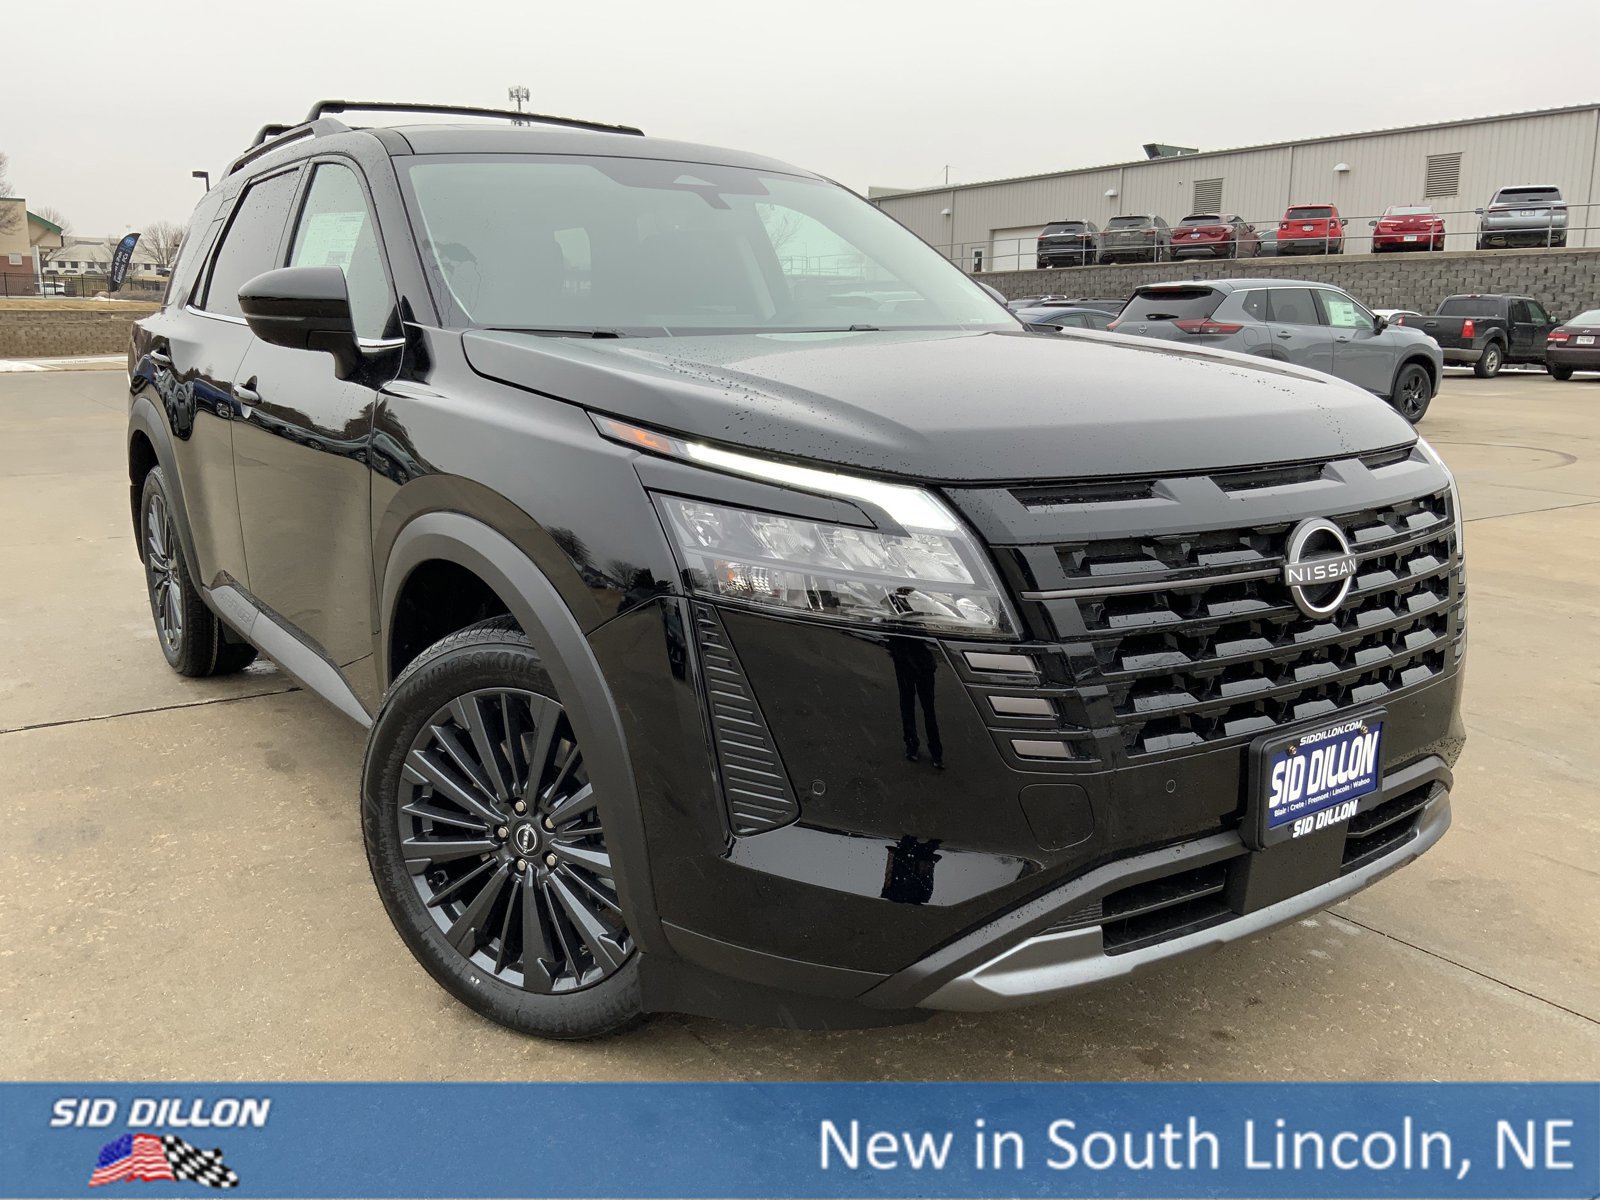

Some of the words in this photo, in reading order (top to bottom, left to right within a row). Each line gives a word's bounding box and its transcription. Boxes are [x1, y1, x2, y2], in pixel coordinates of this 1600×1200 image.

[1288, 558, 1356, 582] NISSAN
[1300, 720, 1363, 746] SIDDILLON.COM
[1269, 755, 1306, 809] SID
[1306, 731, 1379, 796] DILLON
[1290, 801, 1304, 811] Crete
[1308, 791, 1330, 805] Fremont
[1332, 785, 1350, 796] Lincoln
[1352, 777, 1371, 788] Wahoo
[1292, 816, 1314, 839] SID
[1315, 799, 1359, 830] DILLON
